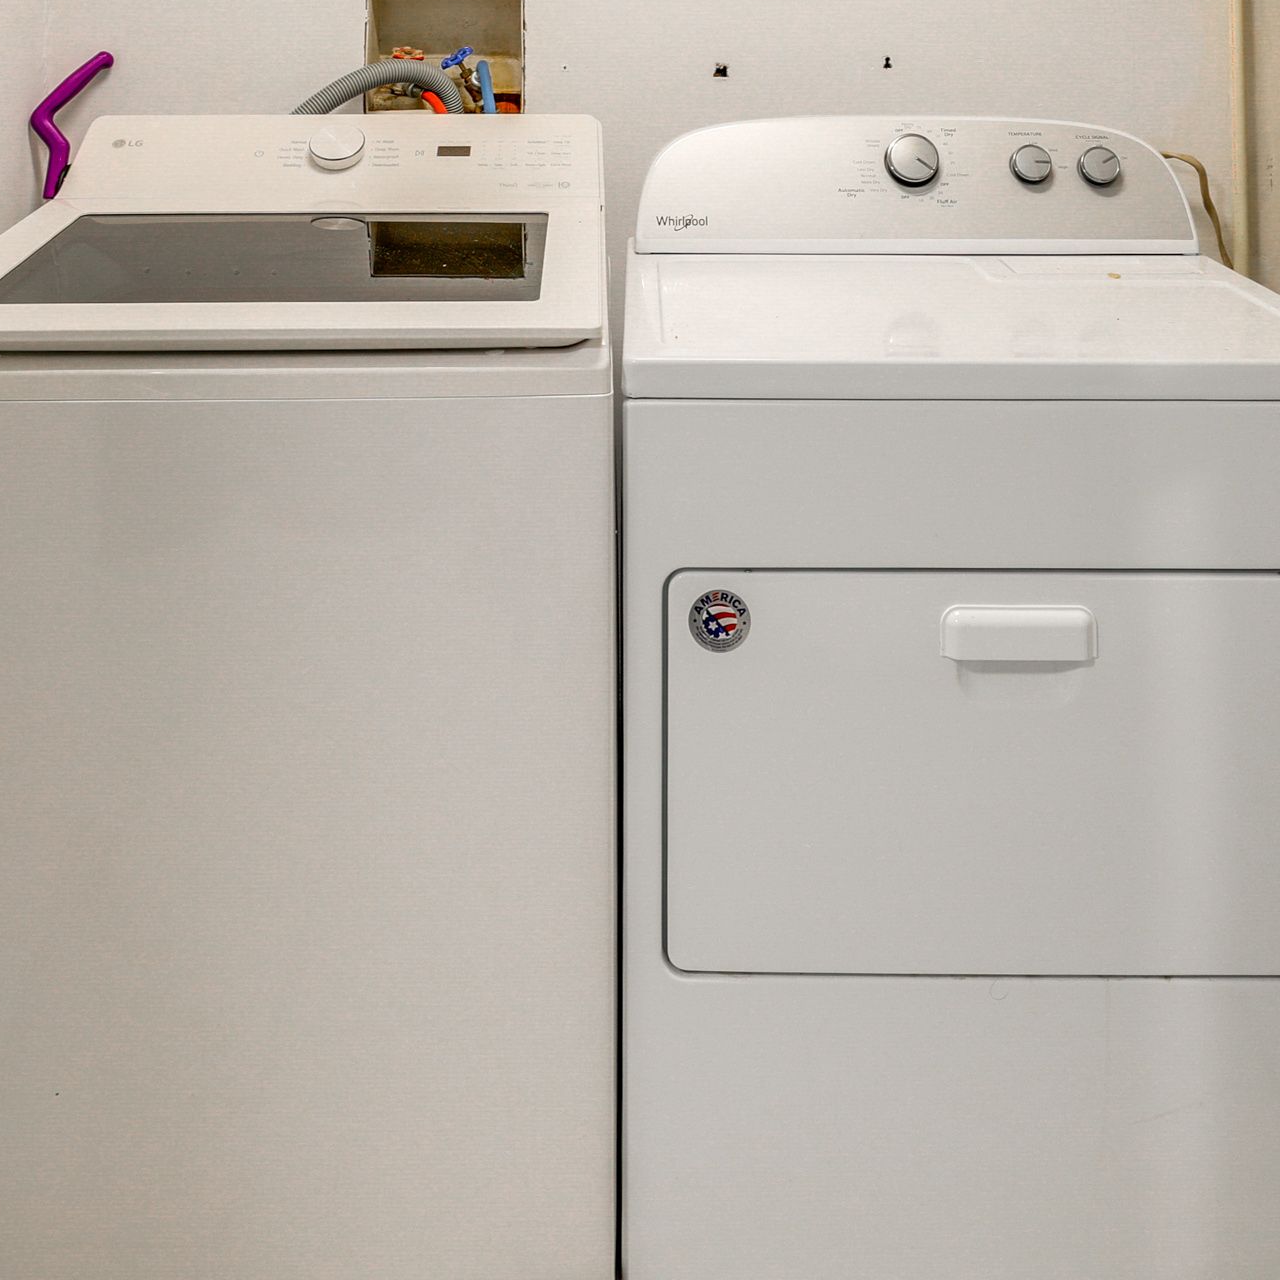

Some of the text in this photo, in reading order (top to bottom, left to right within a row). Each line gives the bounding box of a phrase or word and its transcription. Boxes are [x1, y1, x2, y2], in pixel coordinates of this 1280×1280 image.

[127, 139, 144, 147] LG
[655, 214, 709, 230] Whirlpool
[694, 591, 747, 617] AMERICA
